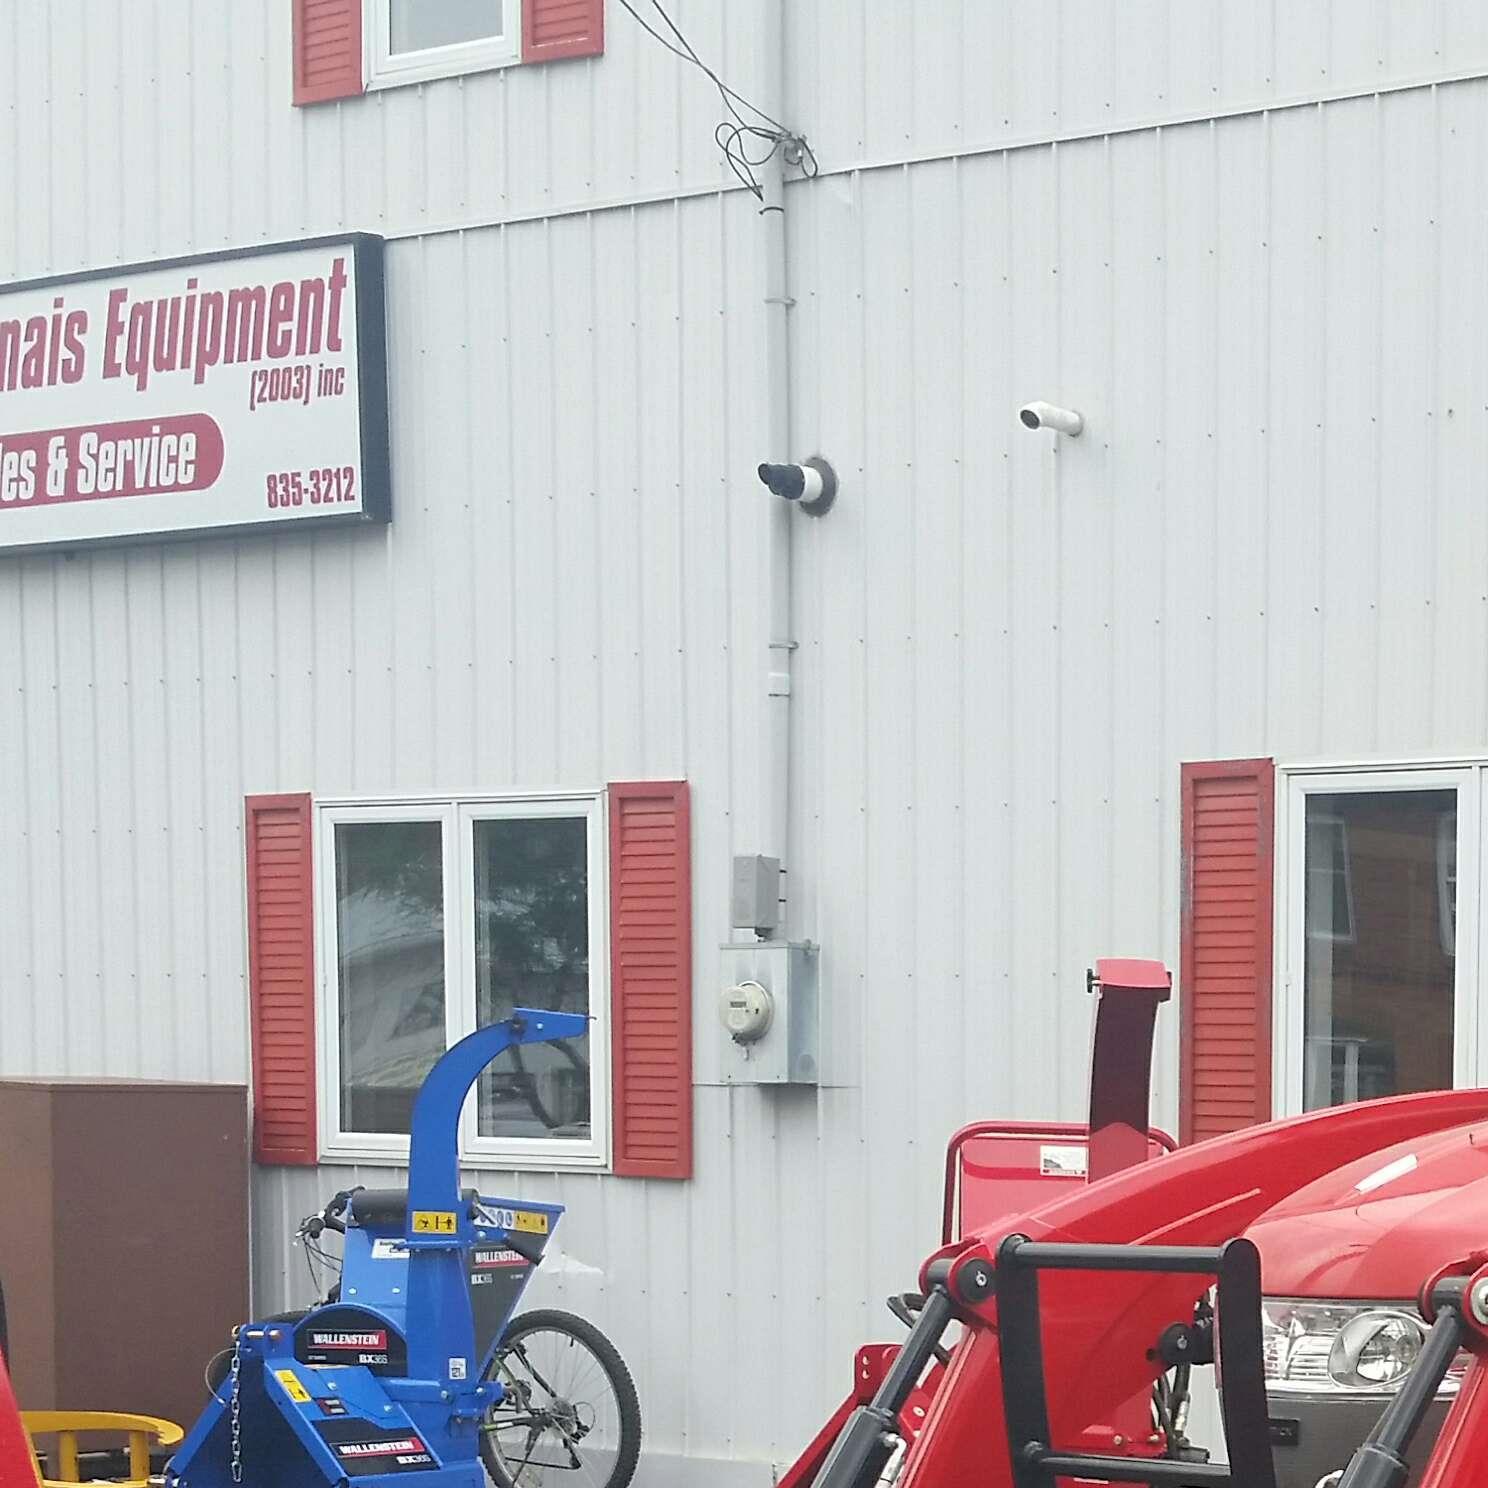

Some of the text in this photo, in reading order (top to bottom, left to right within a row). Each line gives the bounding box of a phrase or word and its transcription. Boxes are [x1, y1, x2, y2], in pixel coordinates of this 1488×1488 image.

[102, 257, 348, 392] Equipment
[317, 363, 346, 397] inc
[46, 435, 69, 496] &
[76, 425, 198, 494] Service
[266, 465, 356, 509] 835-3212
[312, 1333, 380, 1346] WALLENSTEIN
[338, 1440, 415, 1455] WALLENSTEIN
